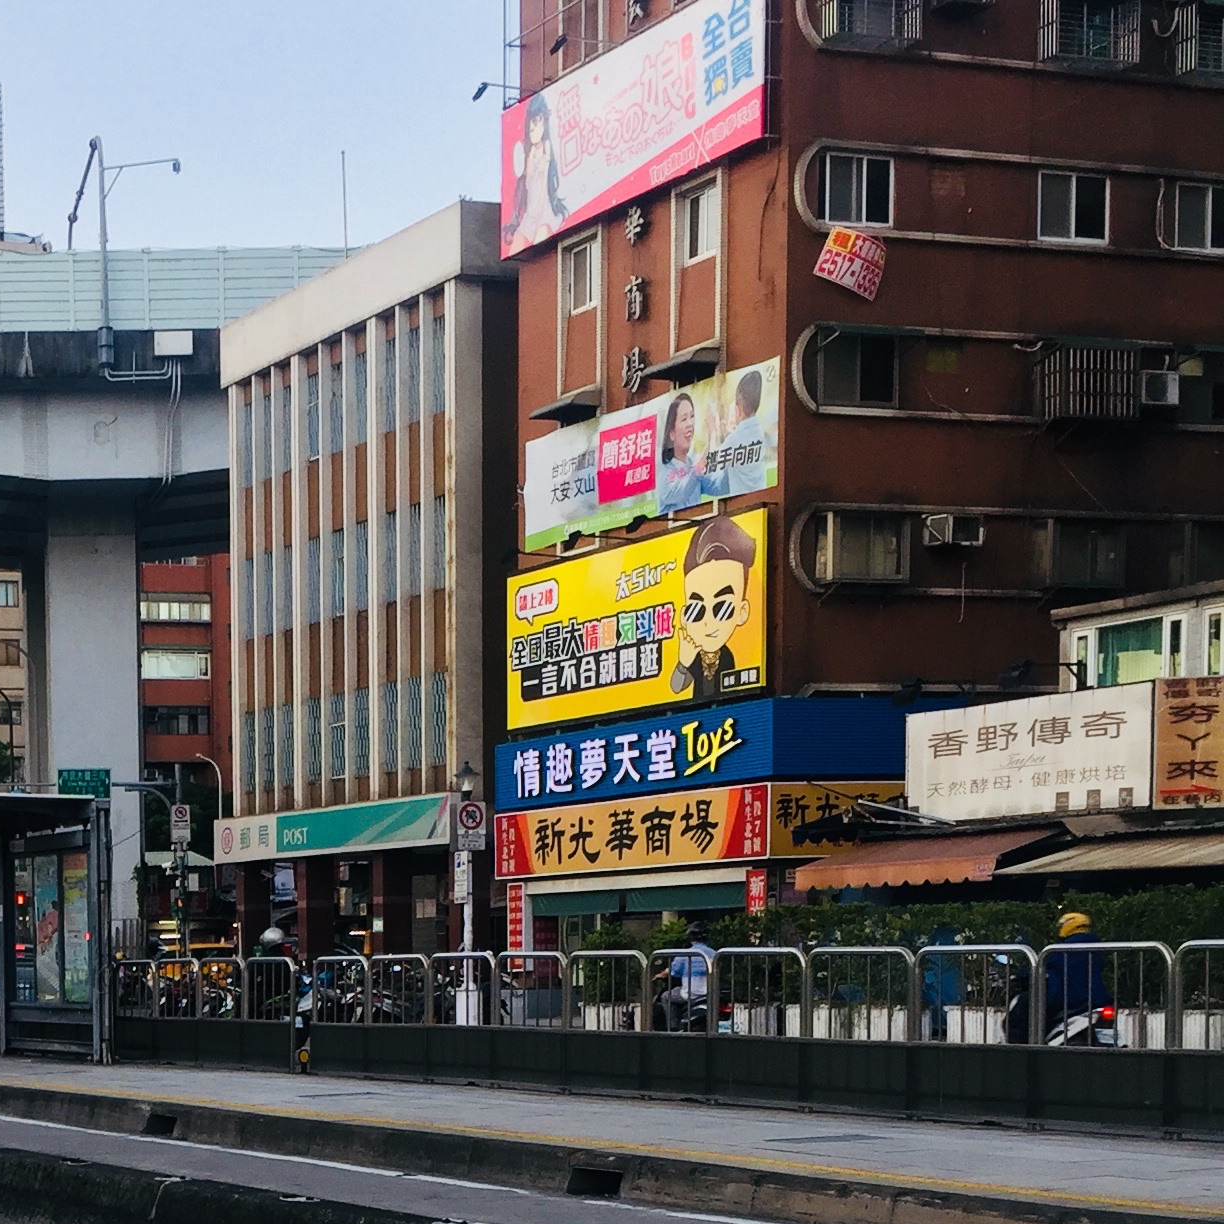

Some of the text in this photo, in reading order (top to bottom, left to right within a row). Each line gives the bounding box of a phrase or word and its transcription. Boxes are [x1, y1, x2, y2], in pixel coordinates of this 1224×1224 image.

[622, 205, 645, 394] 華商場
[600, 428, 653, 472] 簡舒培
[704, 440, 763, 476] 攜手向前
[522, 642, 660, 697] 一言不合就開逛
[513, 717, 738, 799] 情趣夢天堂 Toys
[927, 710, 1128, 759] 香野傳奇
[239, 824, 270, 851] 郵局
[283, 827, 308, 846] POST
[534, 799, 719, 866] 新光華商場
